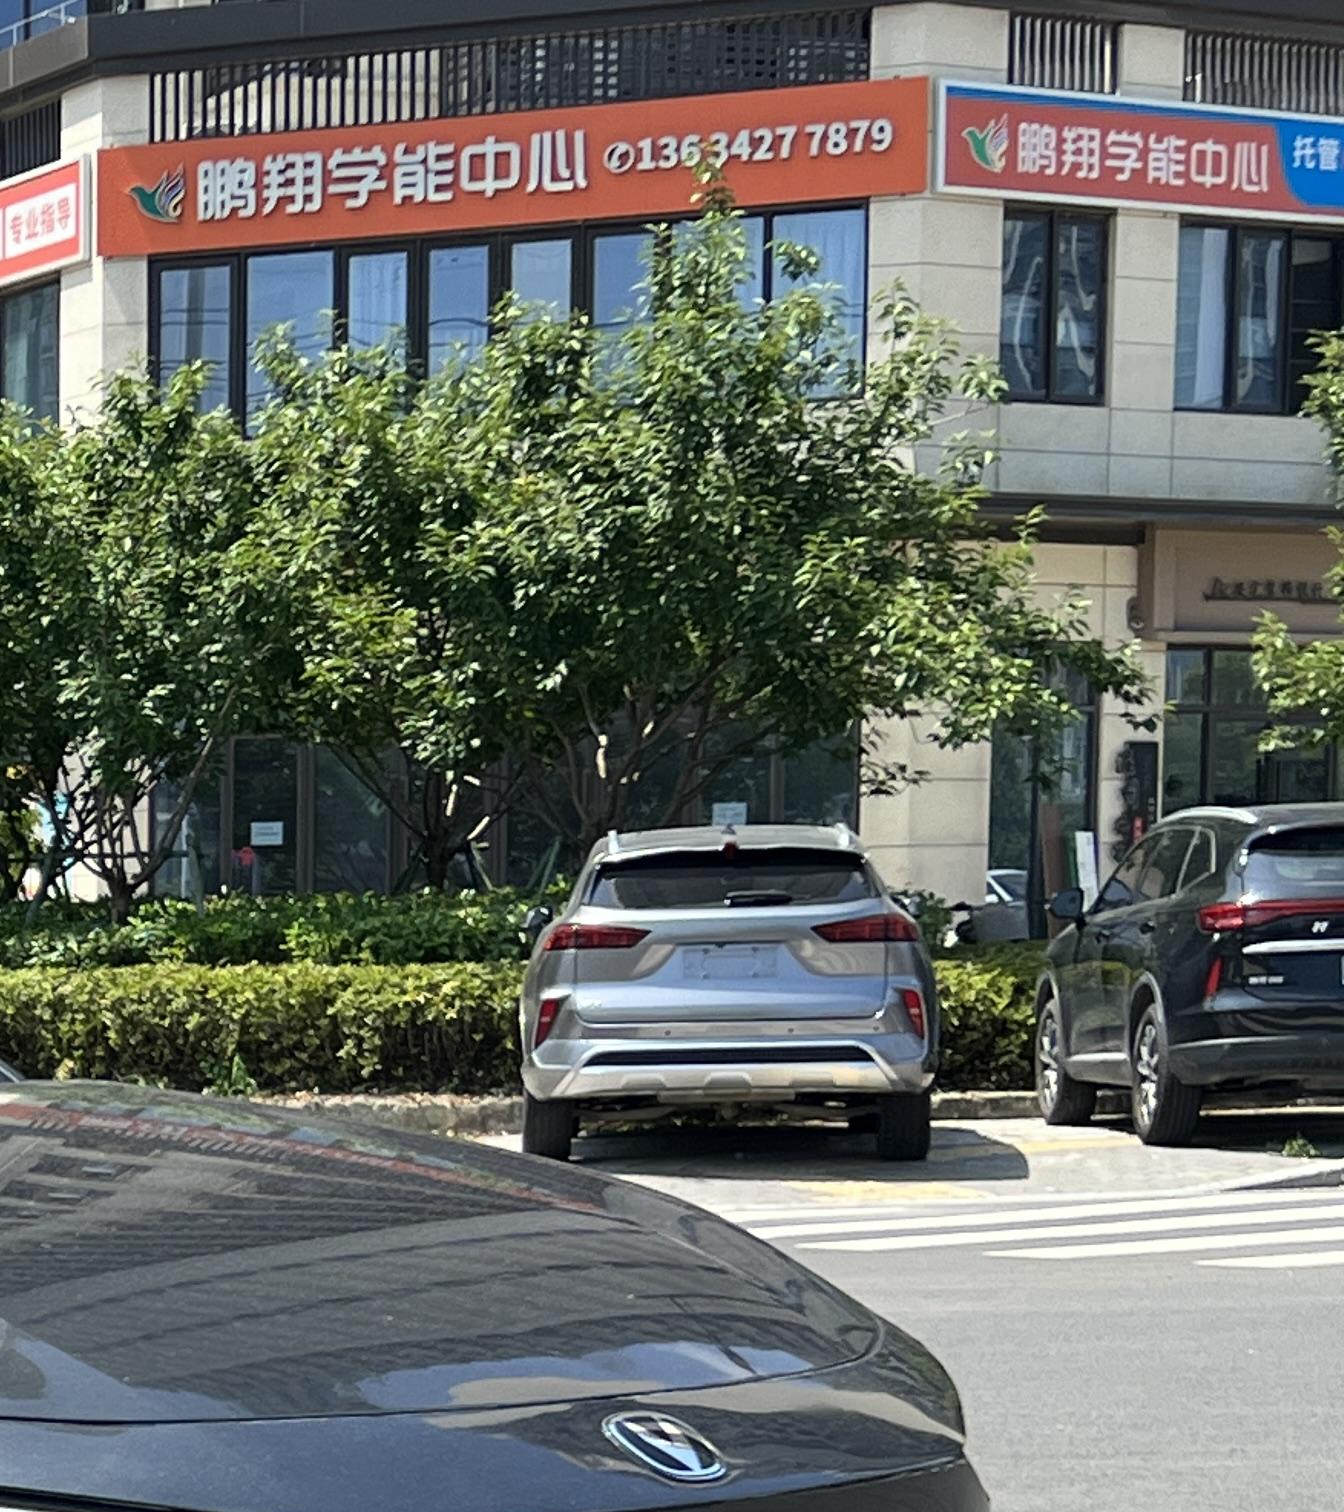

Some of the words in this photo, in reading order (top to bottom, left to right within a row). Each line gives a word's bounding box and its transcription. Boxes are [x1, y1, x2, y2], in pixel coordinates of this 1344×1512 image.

[197, 128, 588, 221] 鹏翔学能中心
[637, 134, 701, 170] 136
[709, 125, 797, 168] 3427
[804, 118, 893, 156] 7879
[1017, 122, 1269, 193] 鹏翔学能中心
[1293, 134, 1340, 171] 托管
[10, 197, 72, 244] 专业指导
